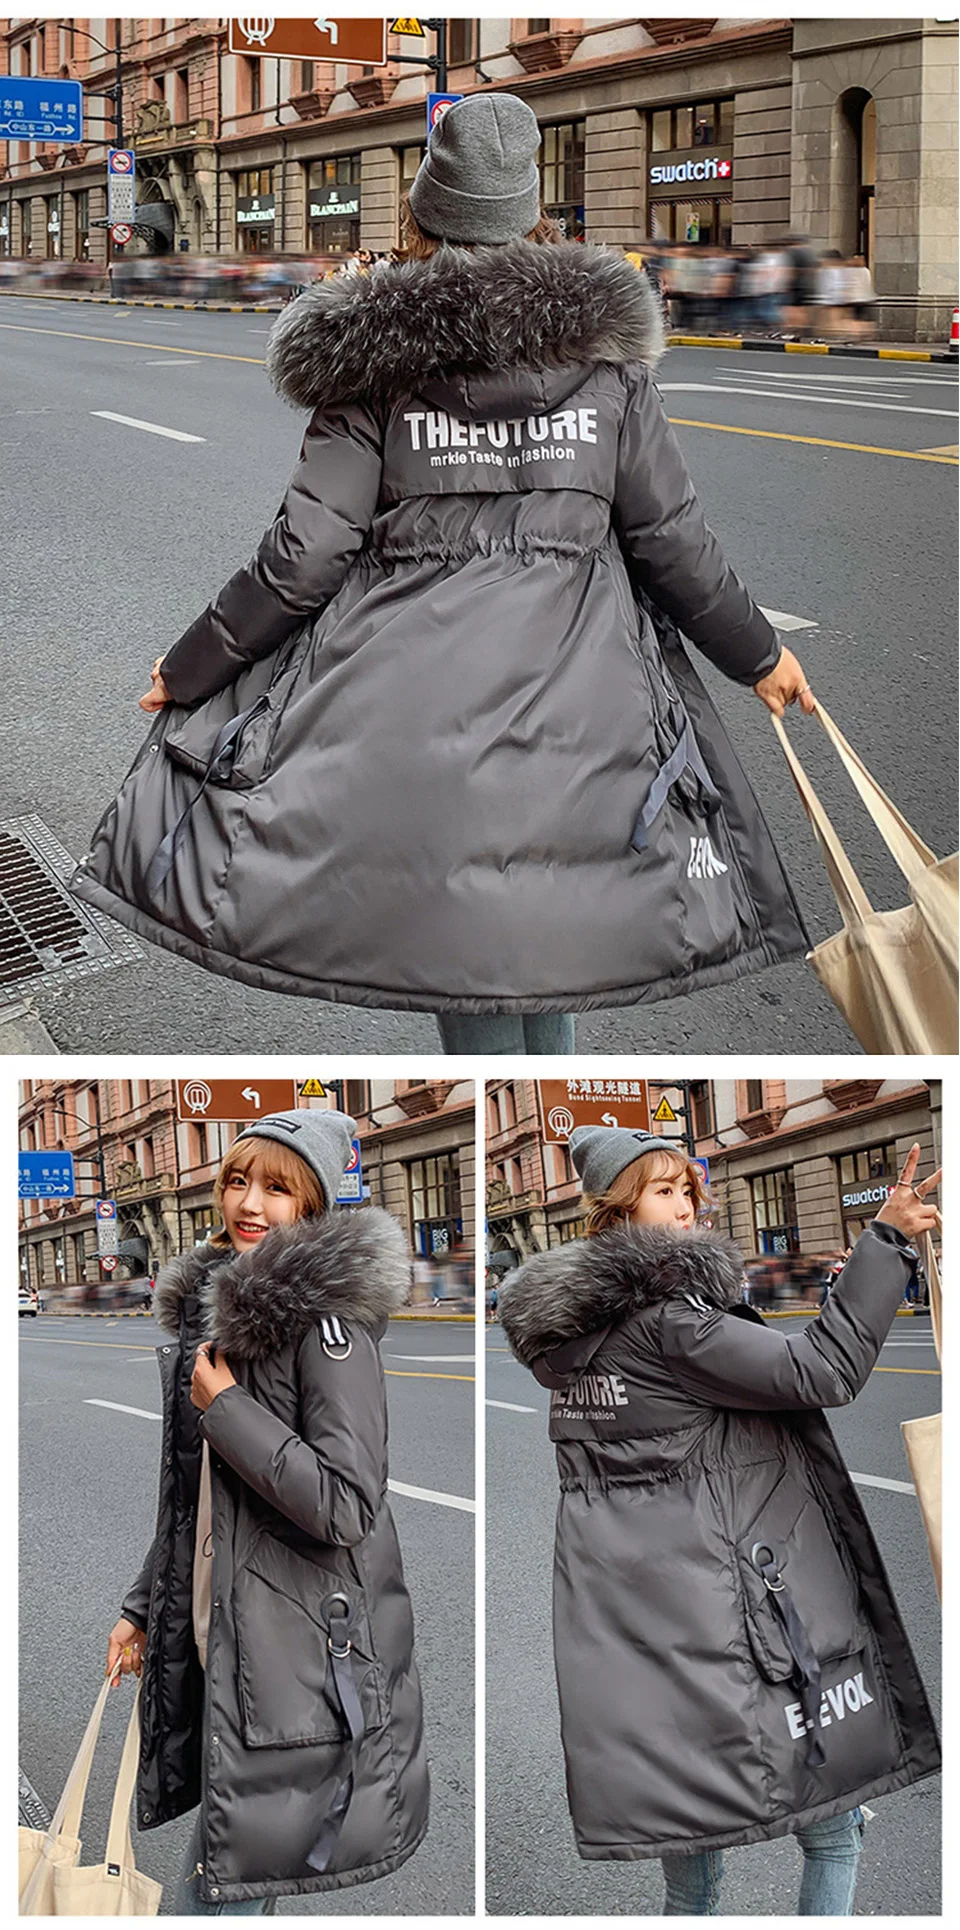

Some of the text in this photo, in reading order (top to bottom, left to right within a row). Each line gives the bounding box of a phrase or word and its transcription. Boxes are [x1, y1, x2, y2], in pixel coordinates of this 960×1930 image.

[0, 100, 24, 110] 东路
[650, 158, 718, 184] swatch
[310, 200, 359, 217] BLANCPAIN
[404, 408, 597, 450] THEFUTURE
[467, 451, 503, 466] Taste
[521, 444, 575, 465] fashion
[567, 1079, 641, 1095] 外滩观光隧道
[842, 1185, 889, 1207] swatch
[562, 1408, 584, 1419] Taste
